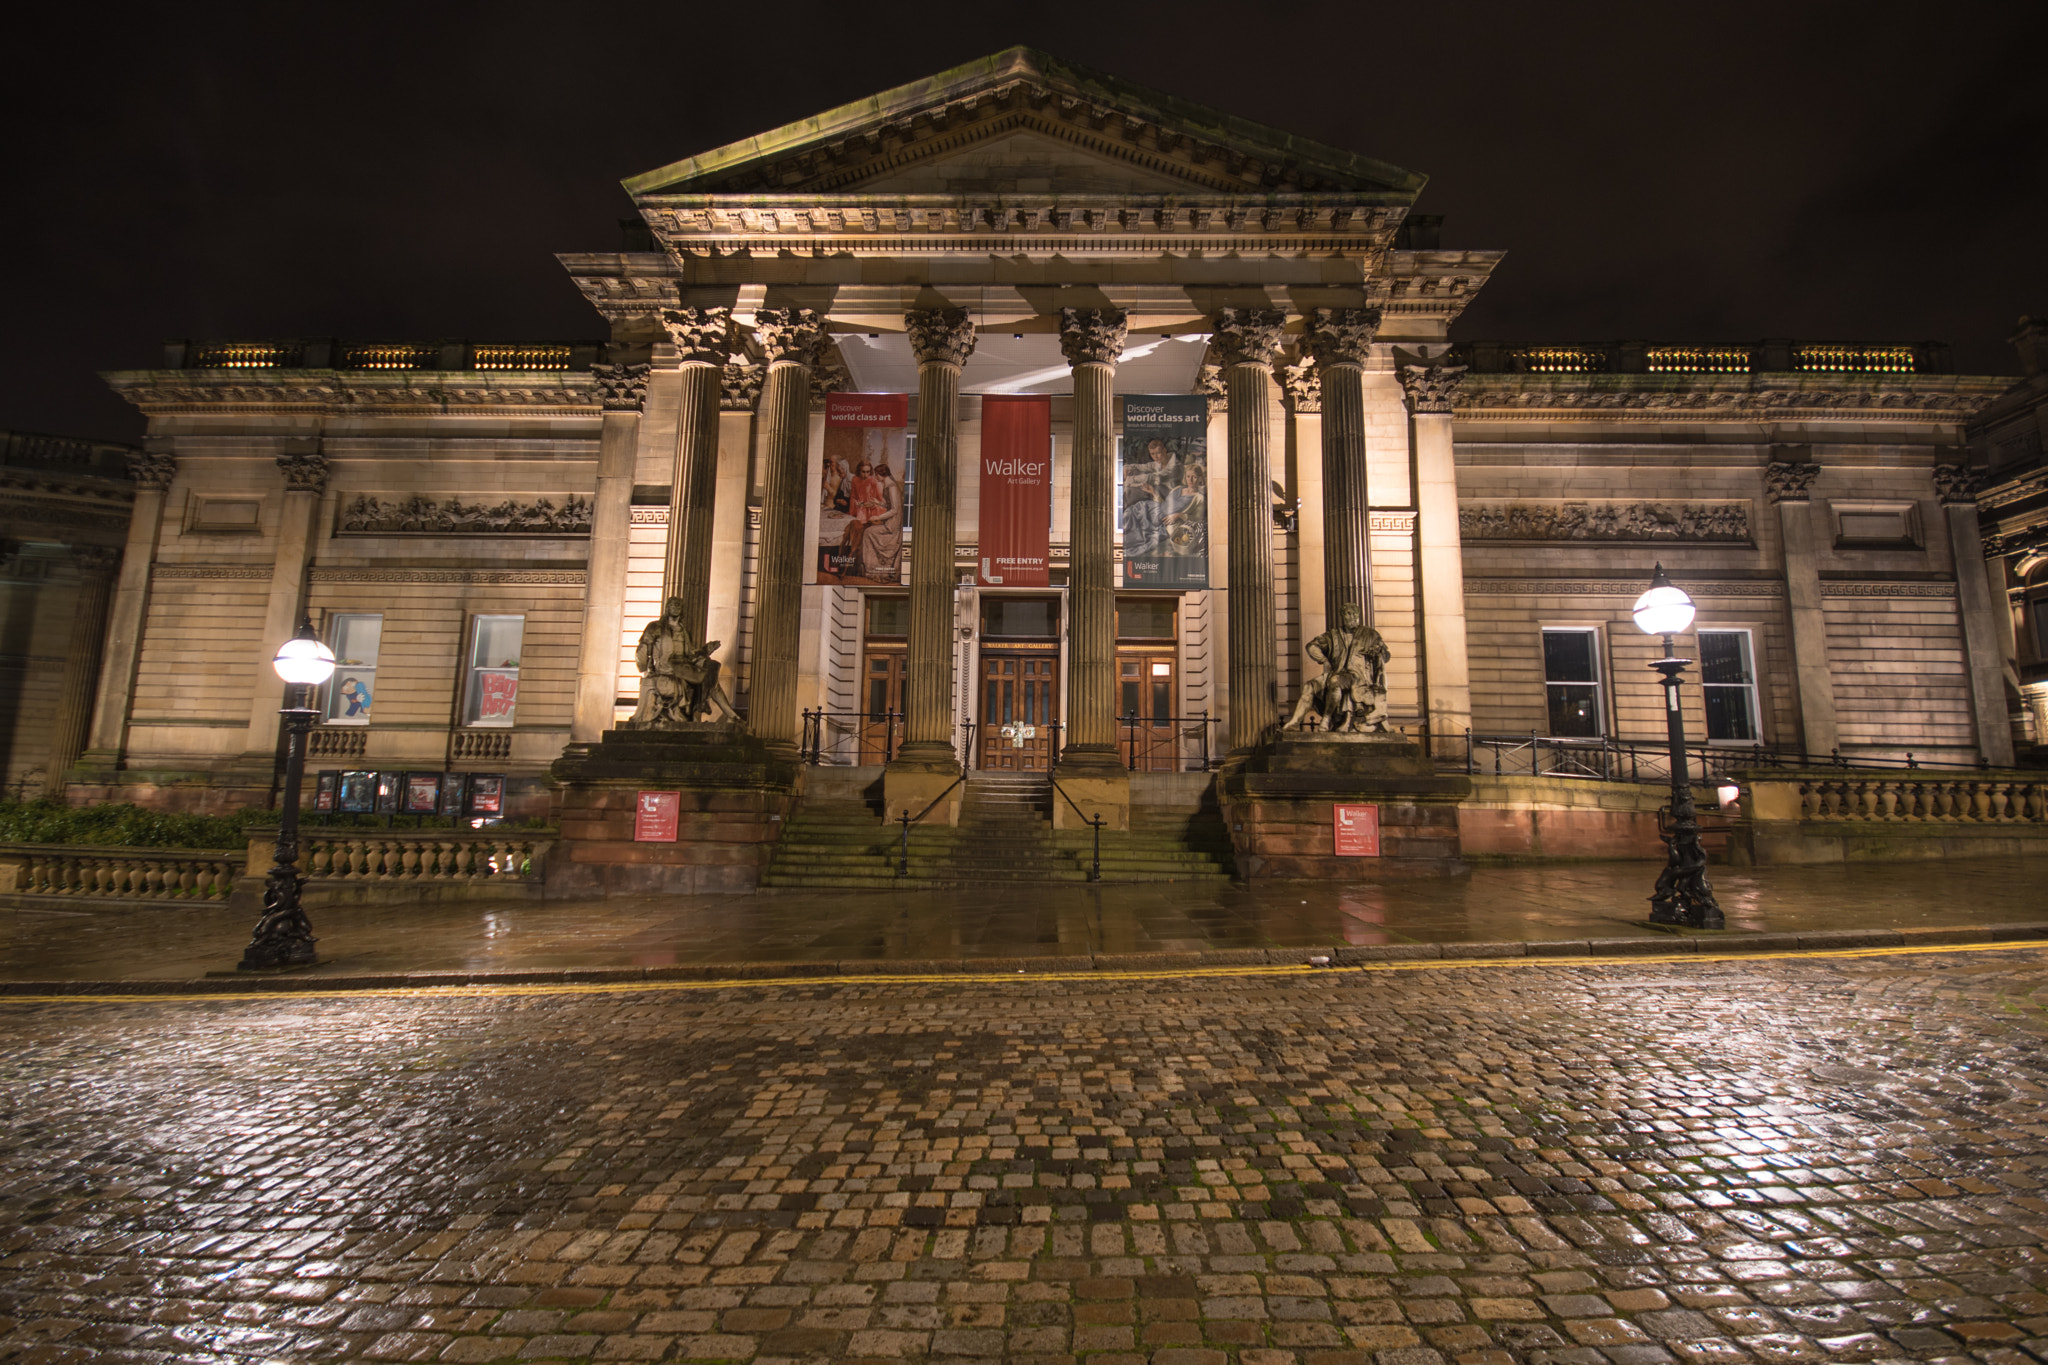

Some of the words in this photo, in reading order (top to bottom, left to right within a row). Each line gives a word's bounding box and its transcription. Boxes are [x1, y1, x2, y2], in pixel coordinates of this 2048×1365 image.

[831, 403, 863, 412] Discover
[1127, 404, 1164, 413] Discover
[831, 413, 855, 421] world
[856, 413, 877, 421] class
[1127, 413, 1157, 422] world
[1158, 413, 1183, 422] class
[1184, 414, 1200, 422] art
[985, 458, 1045, 475] Walker
[1018, 478, 1040, 486] Gallery
[831, 555, 856, 563] Walker
[1017, 557, 1044, 565] ENTRY
[1134, 562, 1159, 570] Walker
